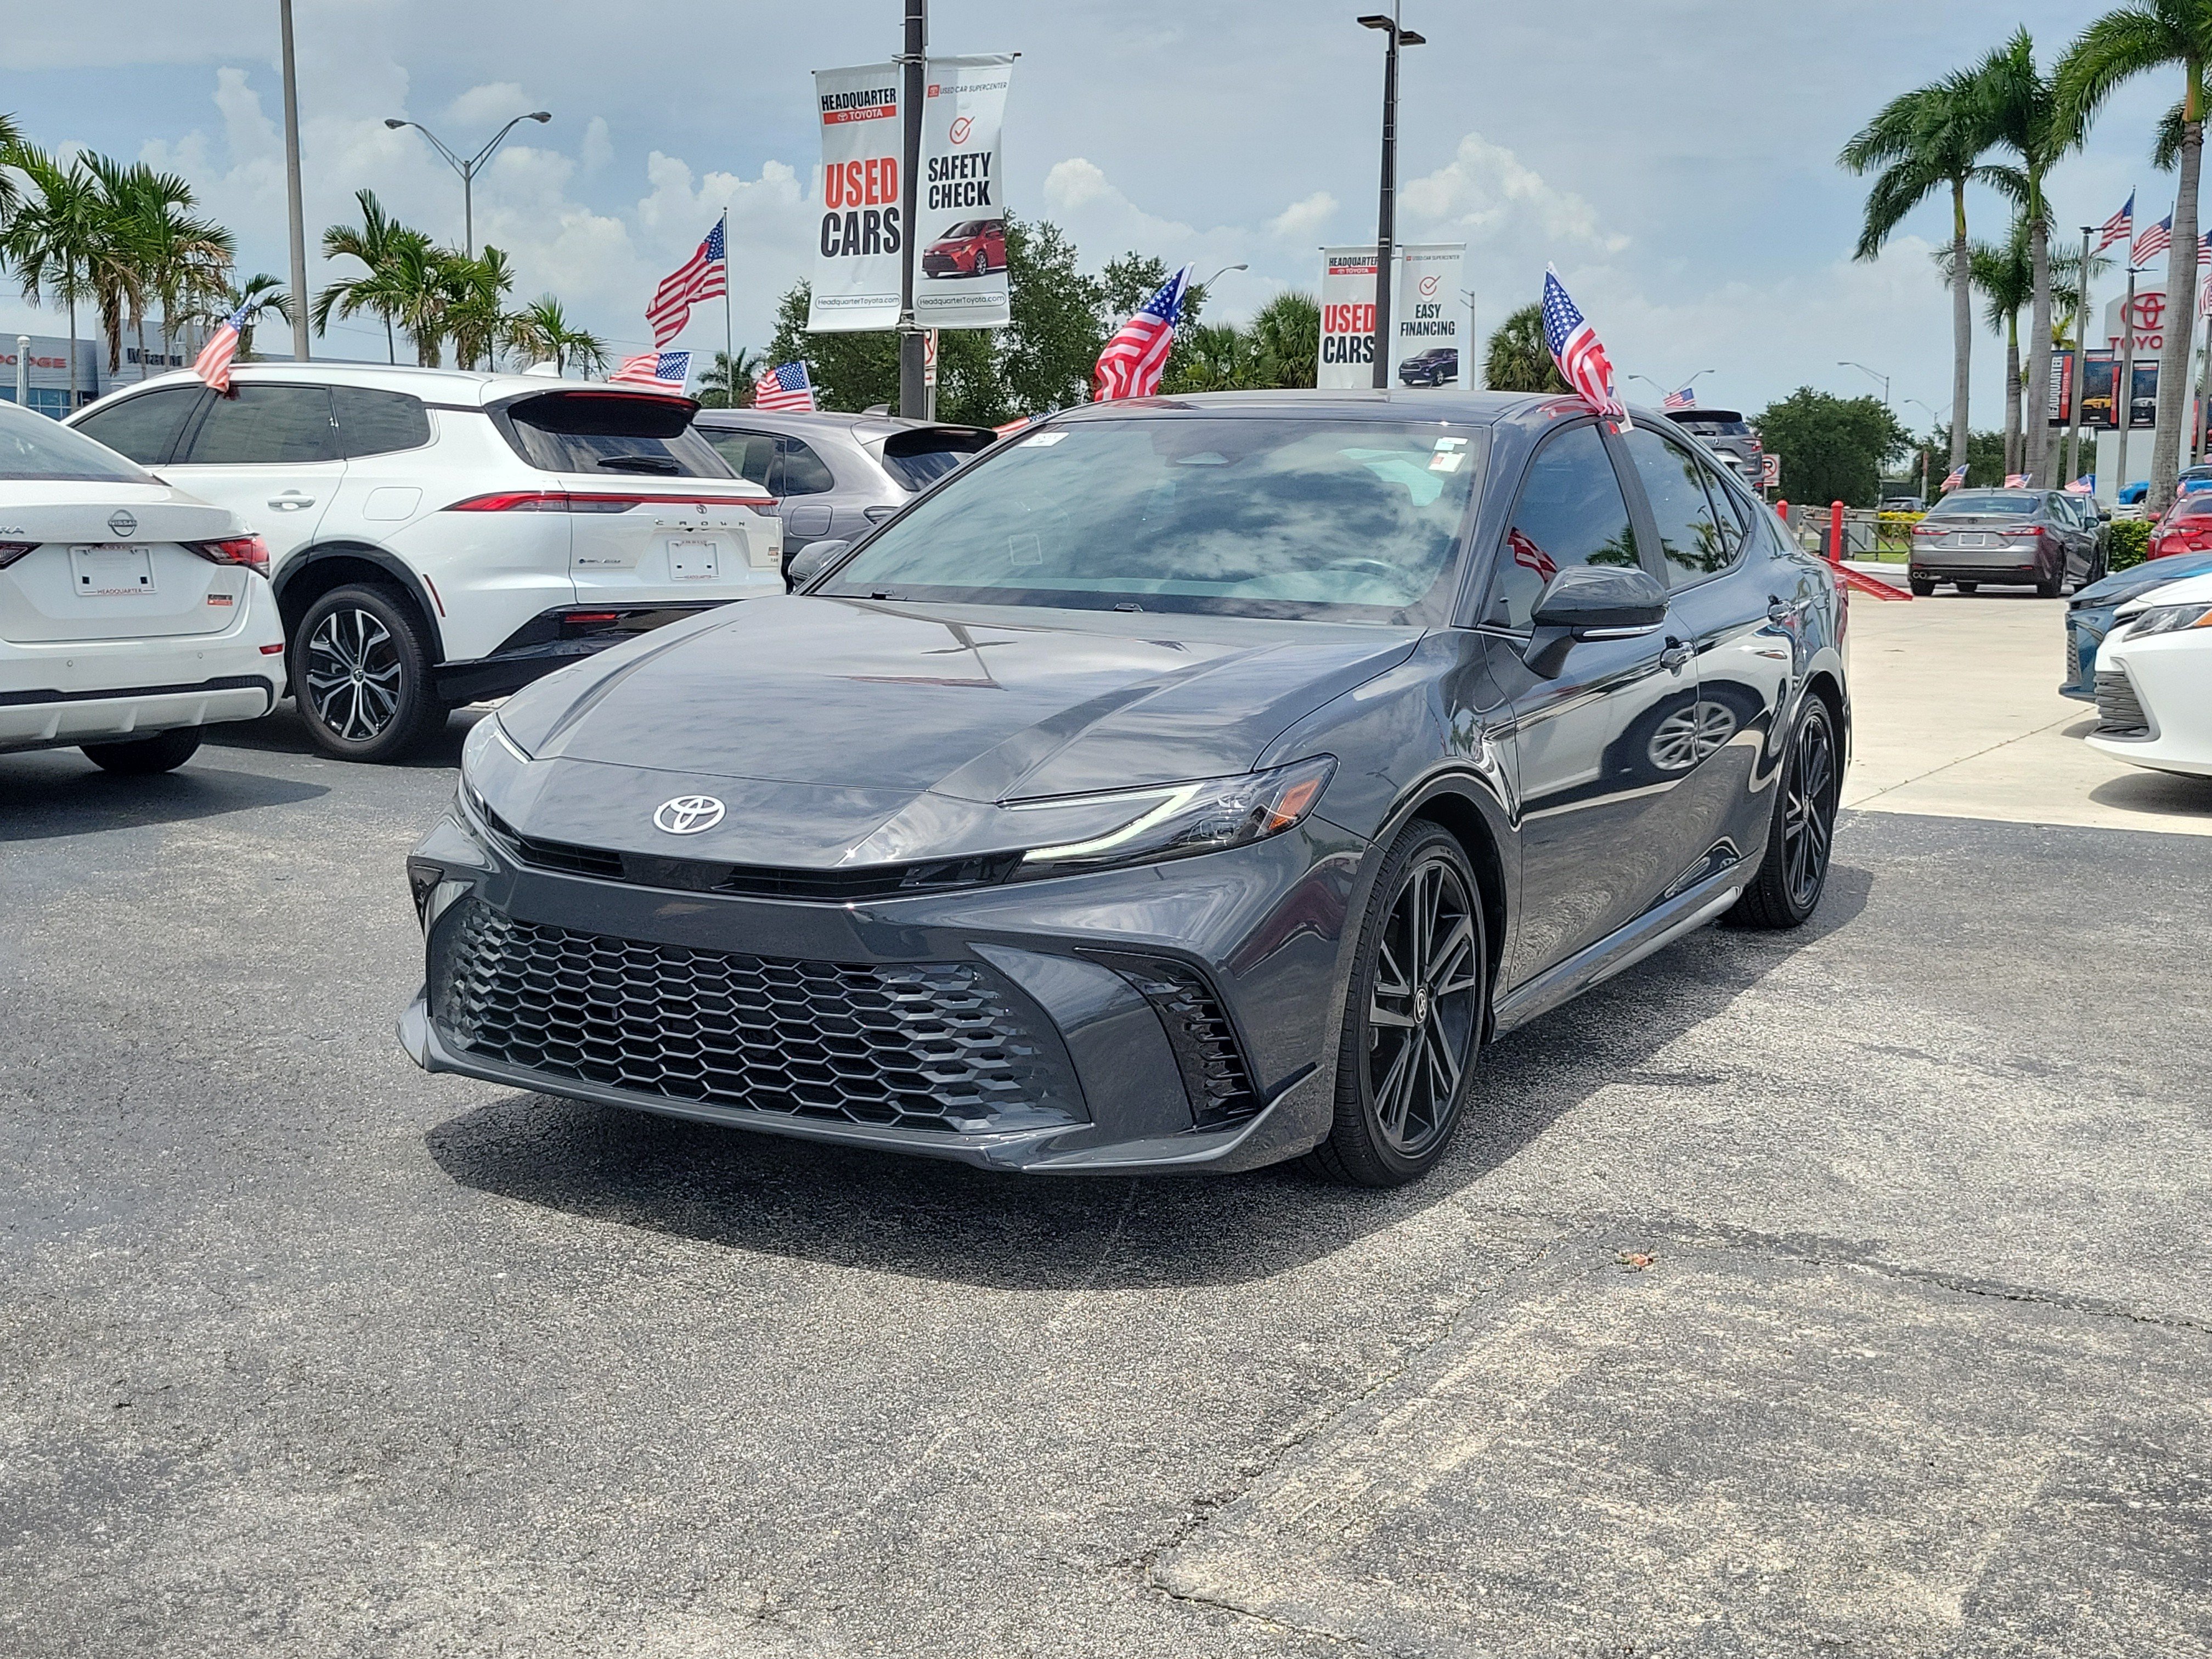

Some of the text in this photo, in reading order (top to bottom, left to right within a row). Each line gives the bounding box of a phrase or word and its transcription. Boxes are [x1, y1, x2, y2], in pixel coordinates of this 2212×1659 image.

[969, 82, 1007, 92] SUPERCENTER
[821, 88, 896, 111] HEADQUARTER
[849, 109, 883, 120] TOYOTA
[928, 151, 992, 183] SAFETY
[825, 157, 898, 209] USED
[929, 180, 991, 210] CHECK
[821, 207, 901, 258] CARS
[818, 296, 900, 307] HeadquarterToyota.com
[919, 295, 1005, 306] HeadquarterToyota.com
[1415, 303, 1442, 319] EASY
[1324, 304, 1376, 333] USED
[1400, 321, 1455, 336] FINANCING
[1323, 335, 1375, 364] CARS
[2108, 335, 2163, 350] TOYO
[2048, 356, 2063, 419] HEADQUARTER
